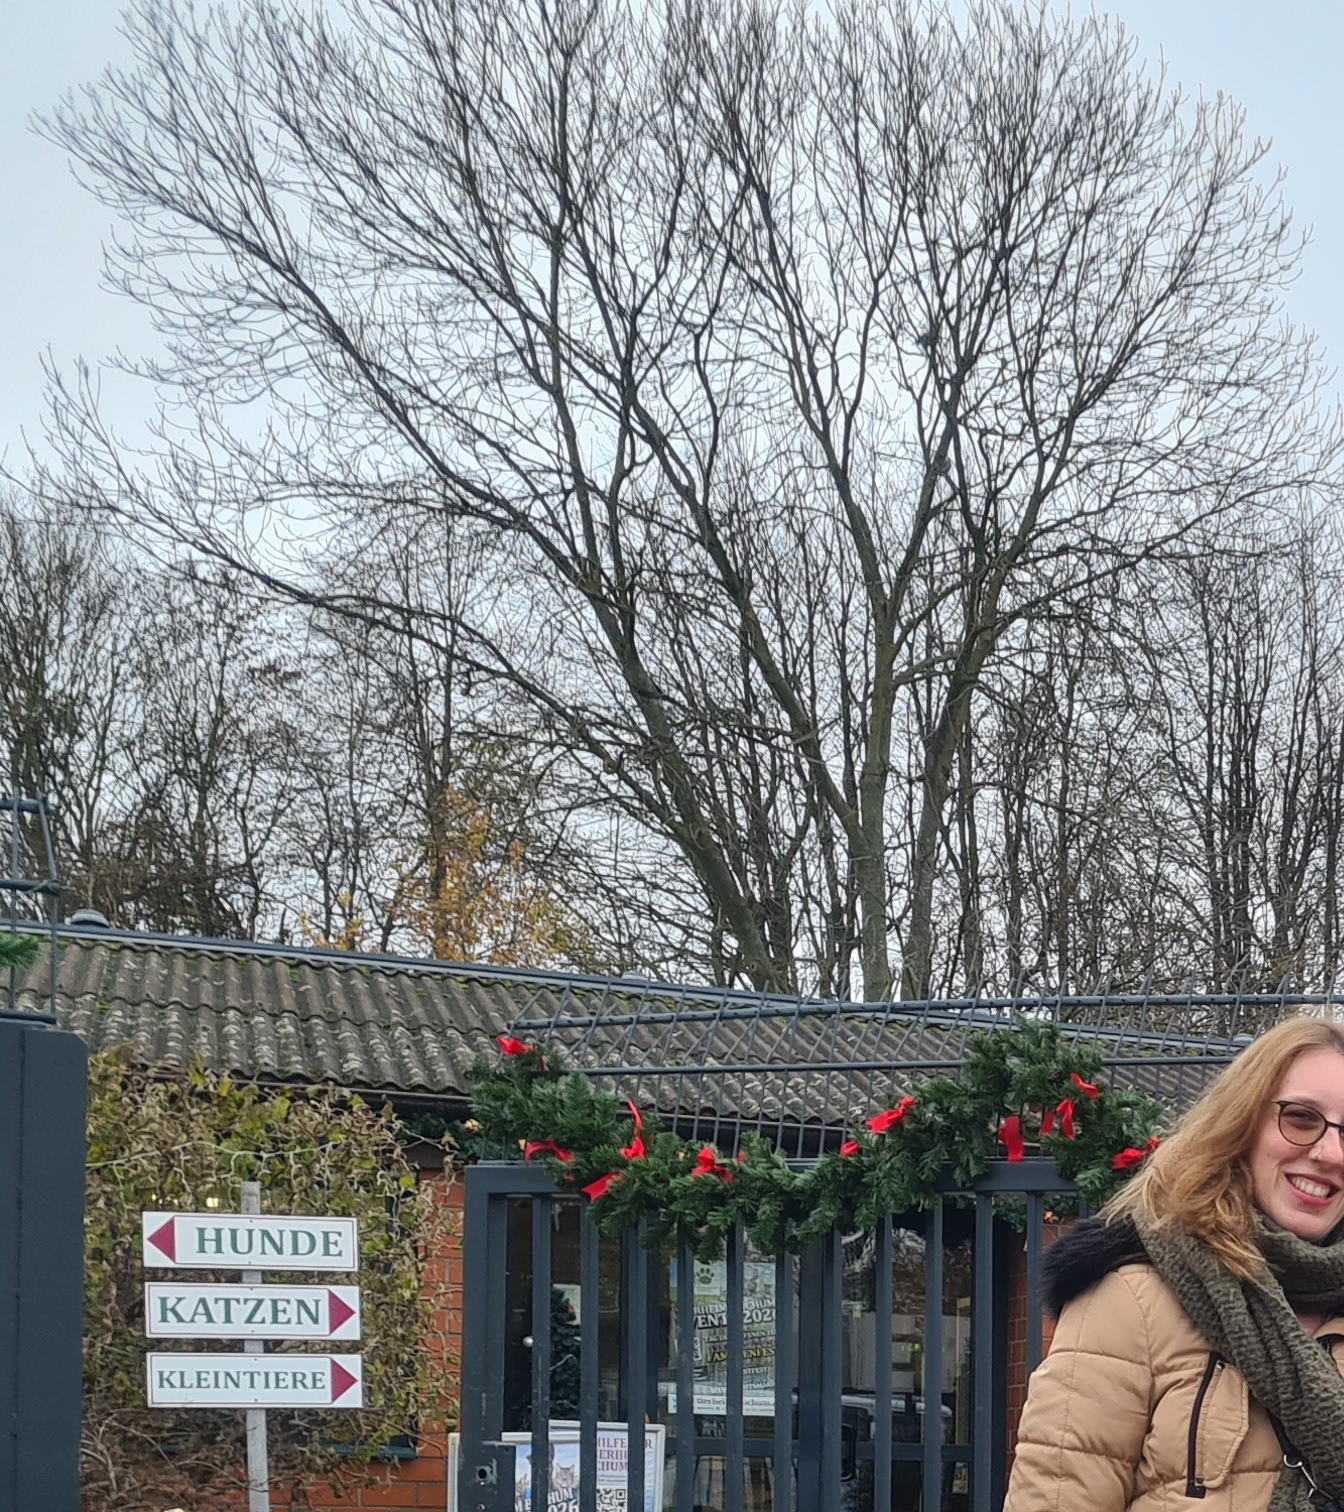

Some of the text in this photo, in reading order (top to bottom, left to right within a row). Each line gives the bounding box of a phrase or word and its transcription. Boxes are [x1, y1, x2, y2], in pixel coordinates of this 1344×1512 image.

[195, 1227, 343, 1258] HUNDE
[157, 1296, 322, 1325] KATZEN
[157, 1370, 326, 1390] KLEINTIERE
